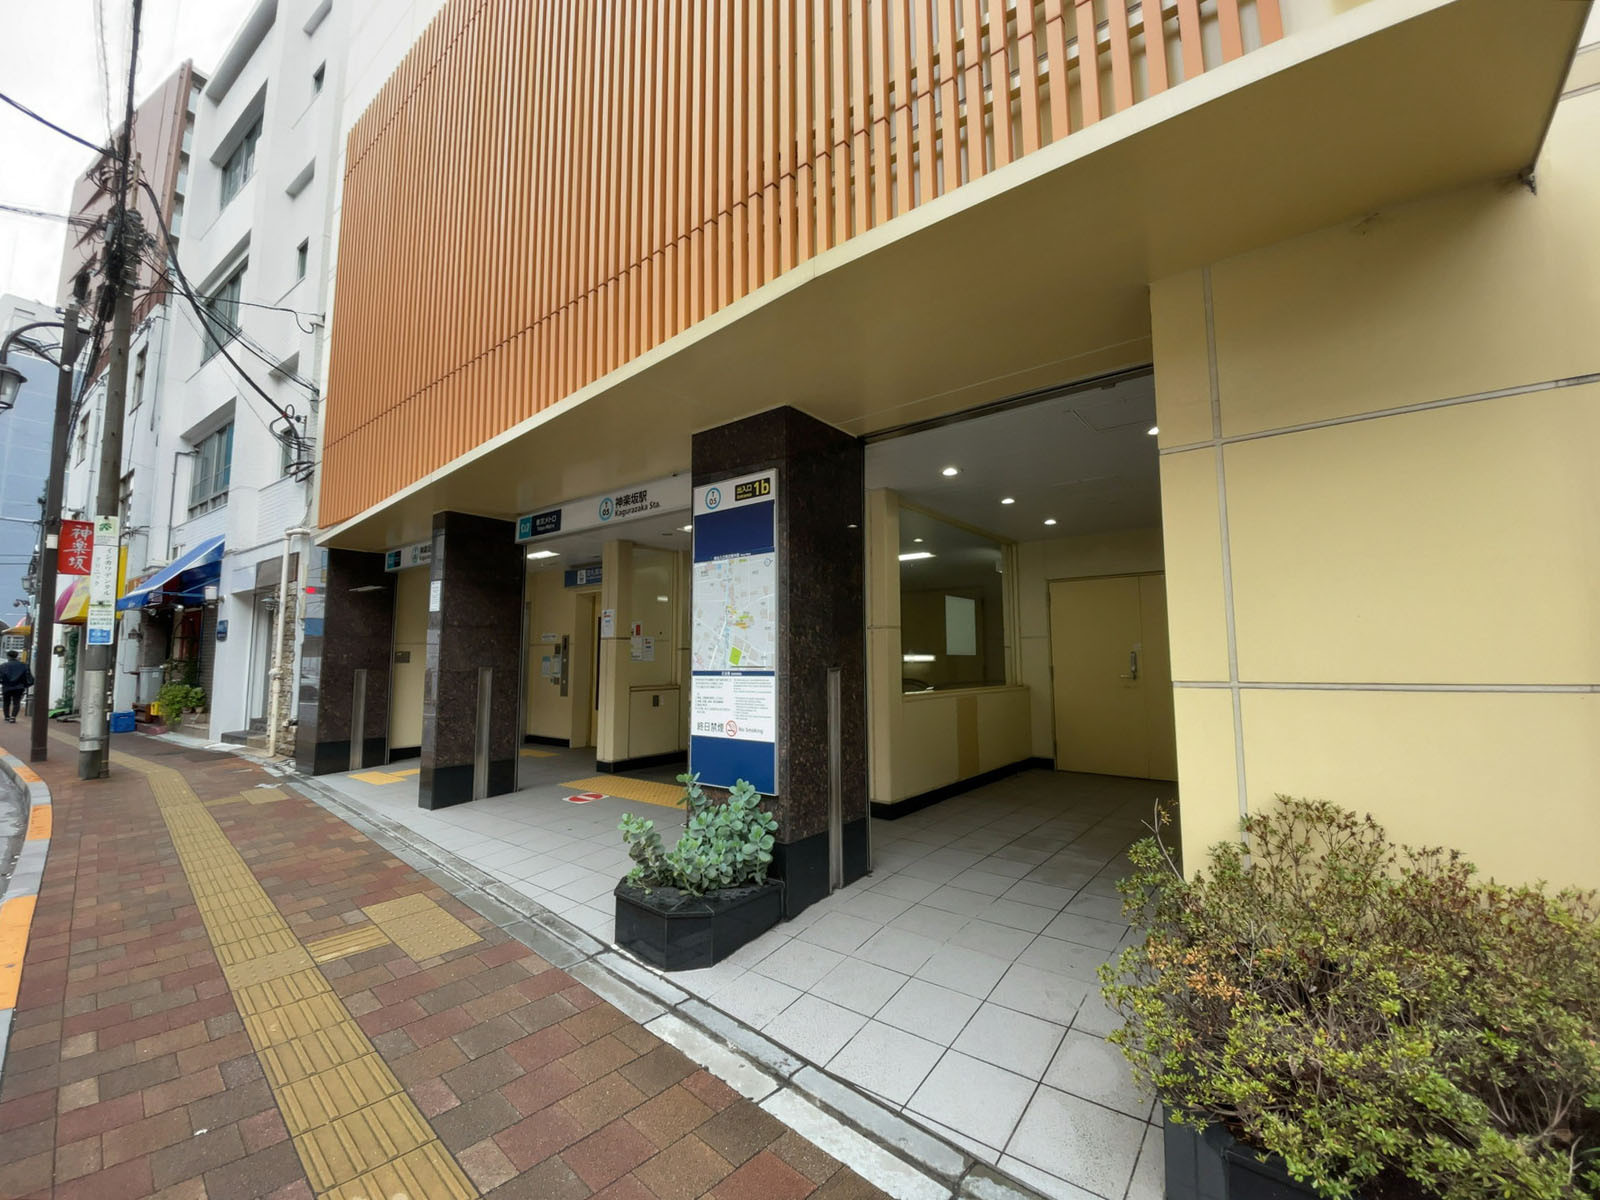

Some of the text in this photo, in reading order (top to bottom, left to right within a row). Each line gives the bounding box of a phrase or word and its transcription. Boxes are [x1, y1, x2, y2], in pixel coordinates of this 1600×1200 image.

[737, 484, 752, 494] 出入口
[754, 480, 770, 496] 1b
[615, 490, 647, 508] 神楽坂駅
[615, 503, 648, 518] Kagurazaka
[63, 525, 92, 573] 神楽坂
[697, 721, 724, 733] 終日禁煙
